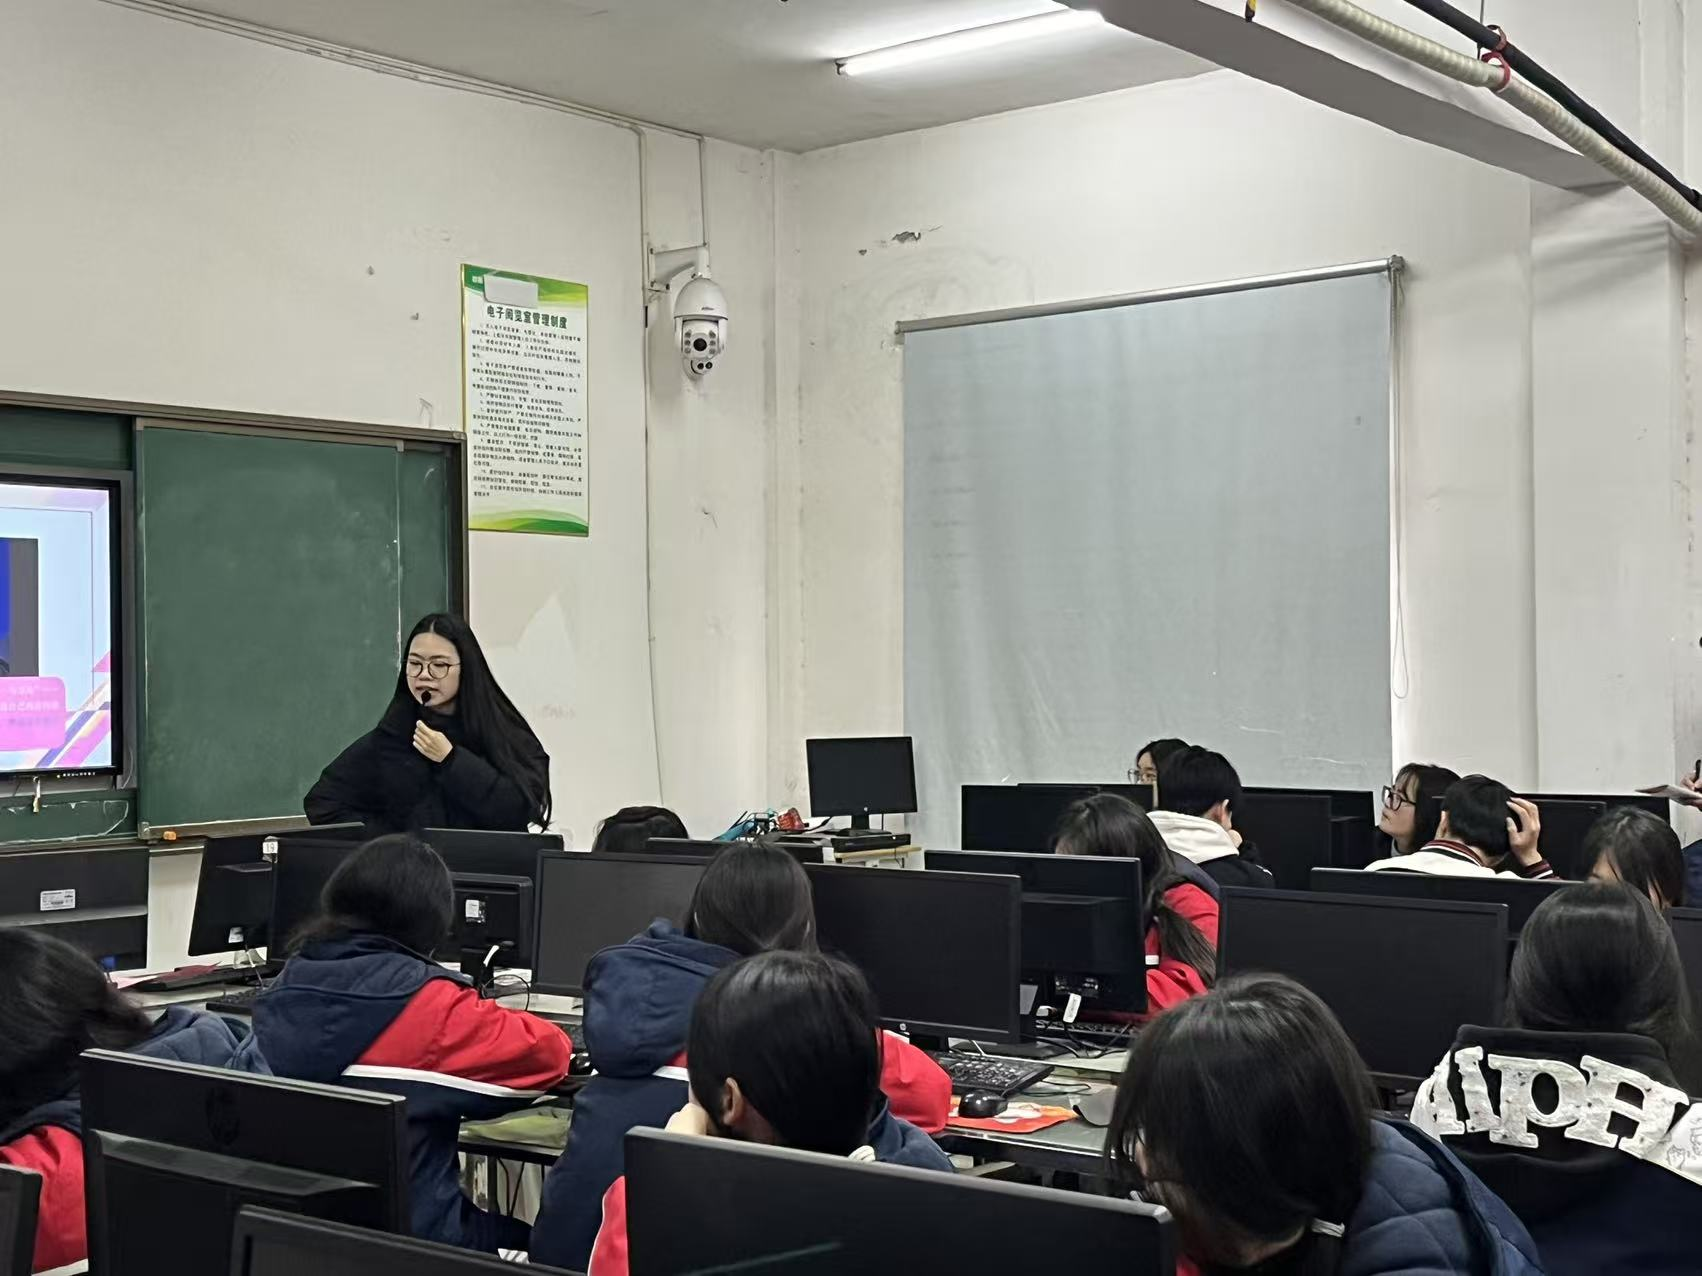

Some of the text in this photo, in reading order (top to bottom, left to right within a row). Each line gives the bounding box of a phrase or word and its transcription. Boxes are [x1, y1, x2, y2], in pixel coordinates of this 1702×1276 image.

[486, 305, 568, 329] 电子阅览室管理制度
